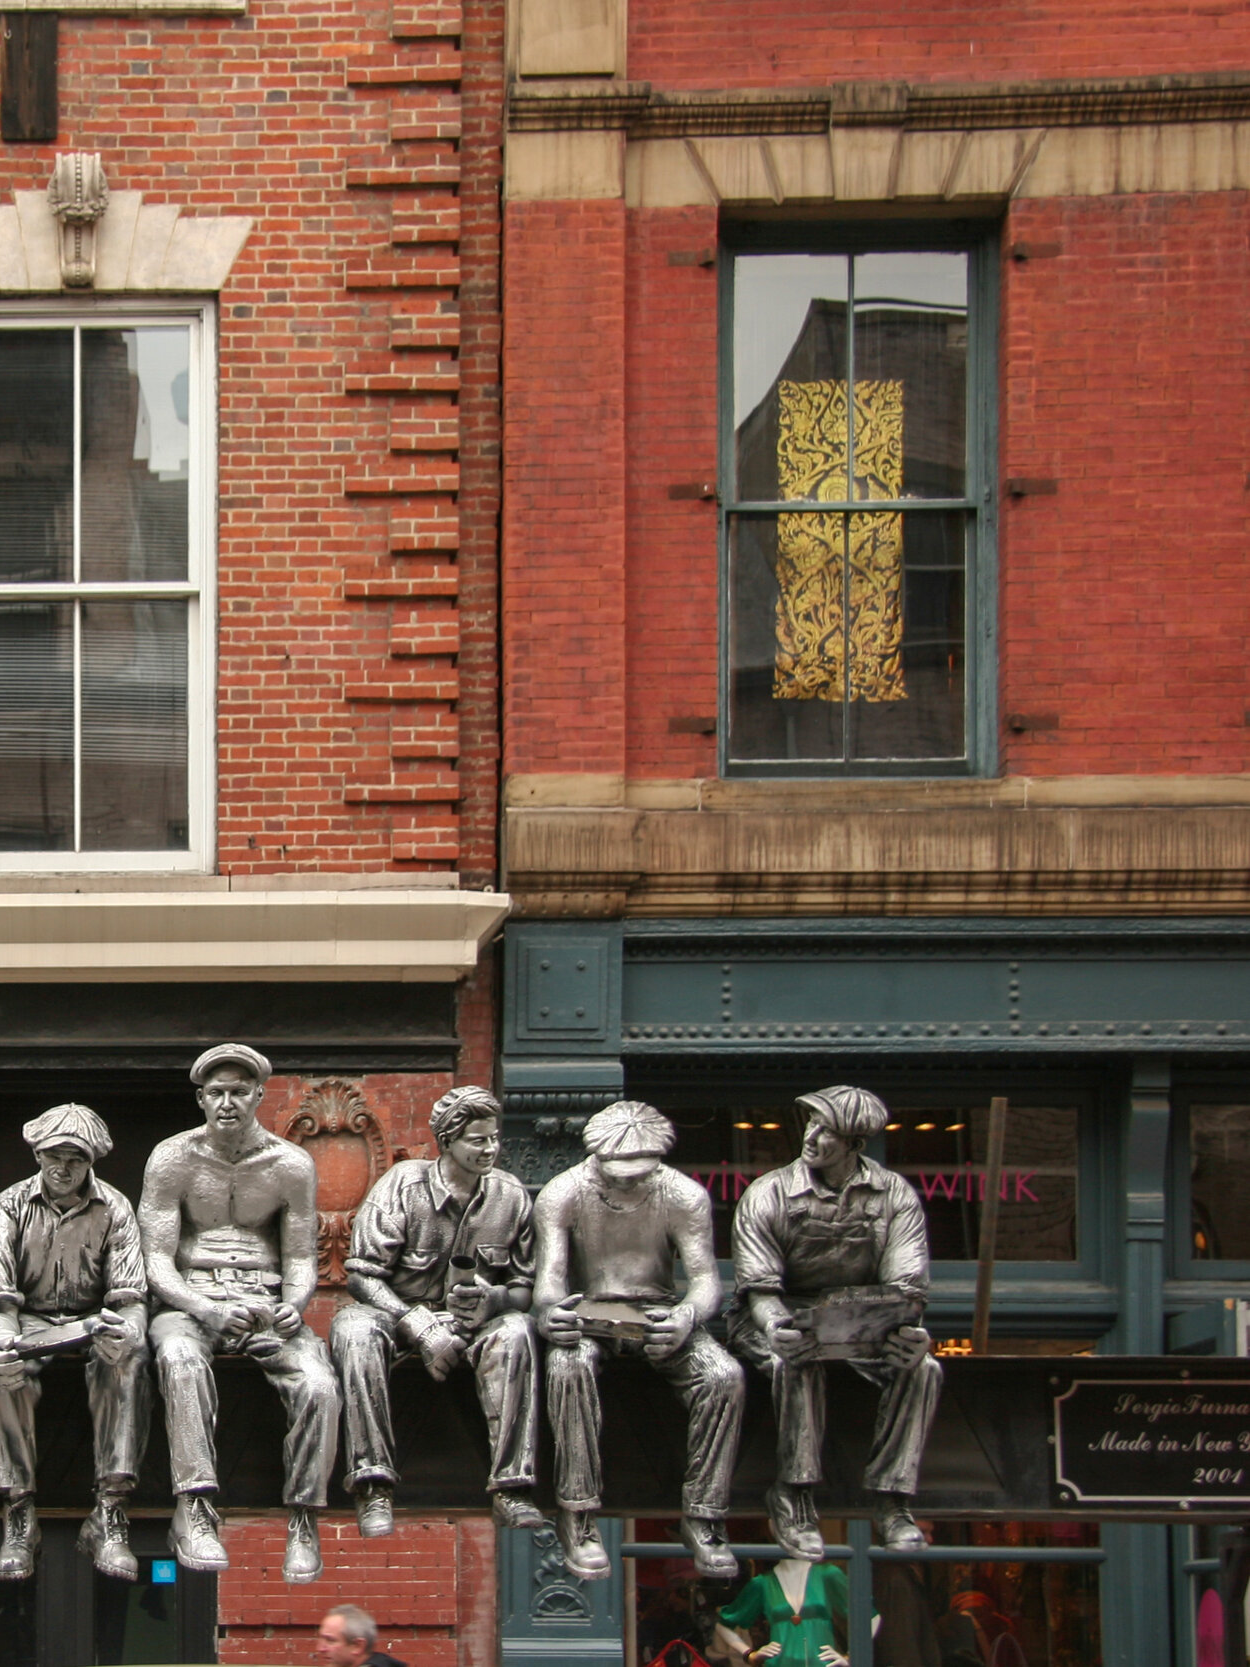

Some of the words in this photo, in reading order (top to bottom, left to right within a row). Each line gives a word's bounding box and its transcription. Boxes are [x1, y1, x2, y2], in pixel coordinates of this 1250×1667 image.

[1114, 1393, 1181, 1423] Sergio
[1088, 1431, 1152, 1452] Made
[1157, 1434, 1180, 1452] in
[1181, 1431, 1233, 1452] New
[1193, 1467, 1244, 1484] 2001
